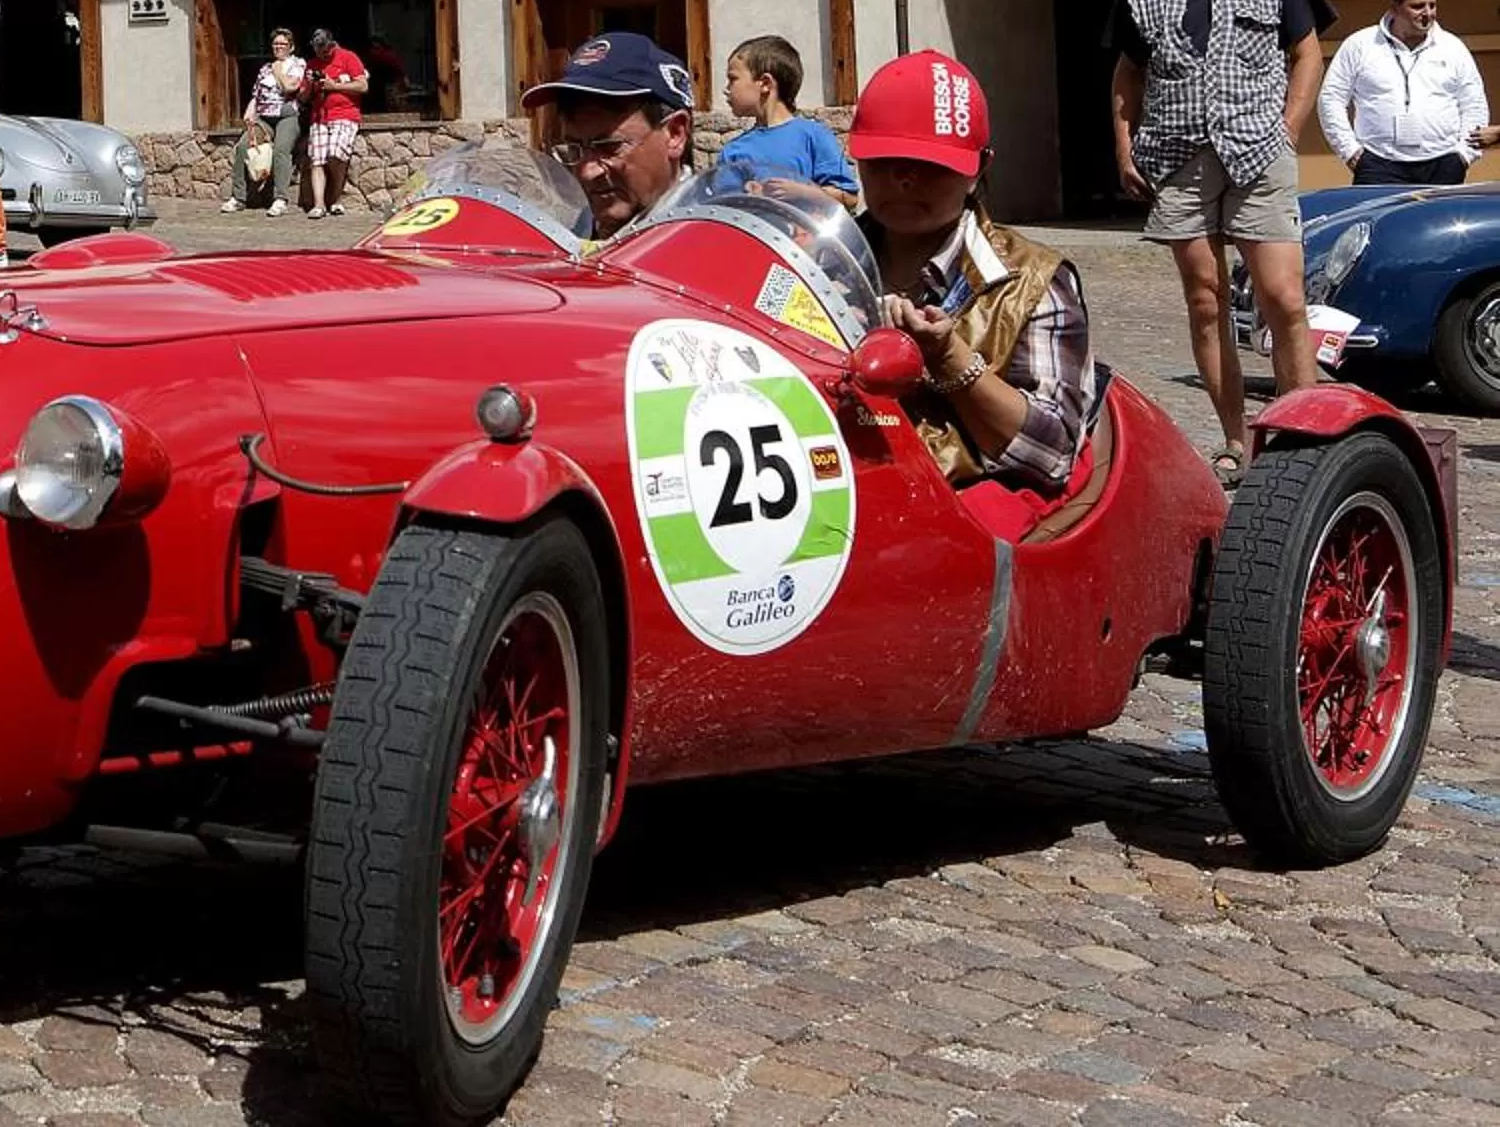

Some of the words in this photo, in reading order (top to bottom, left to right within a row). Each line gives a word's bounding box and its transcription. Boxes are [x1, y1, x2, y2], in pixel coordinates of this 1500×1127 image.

[952, 74, 971, 138] CORSE
[387, 207, 452, 228] 25
[699, 423, 799, 529] 25
[726, 586, 776, 606] Banca
[725, 601, 796, 629] Galileo
